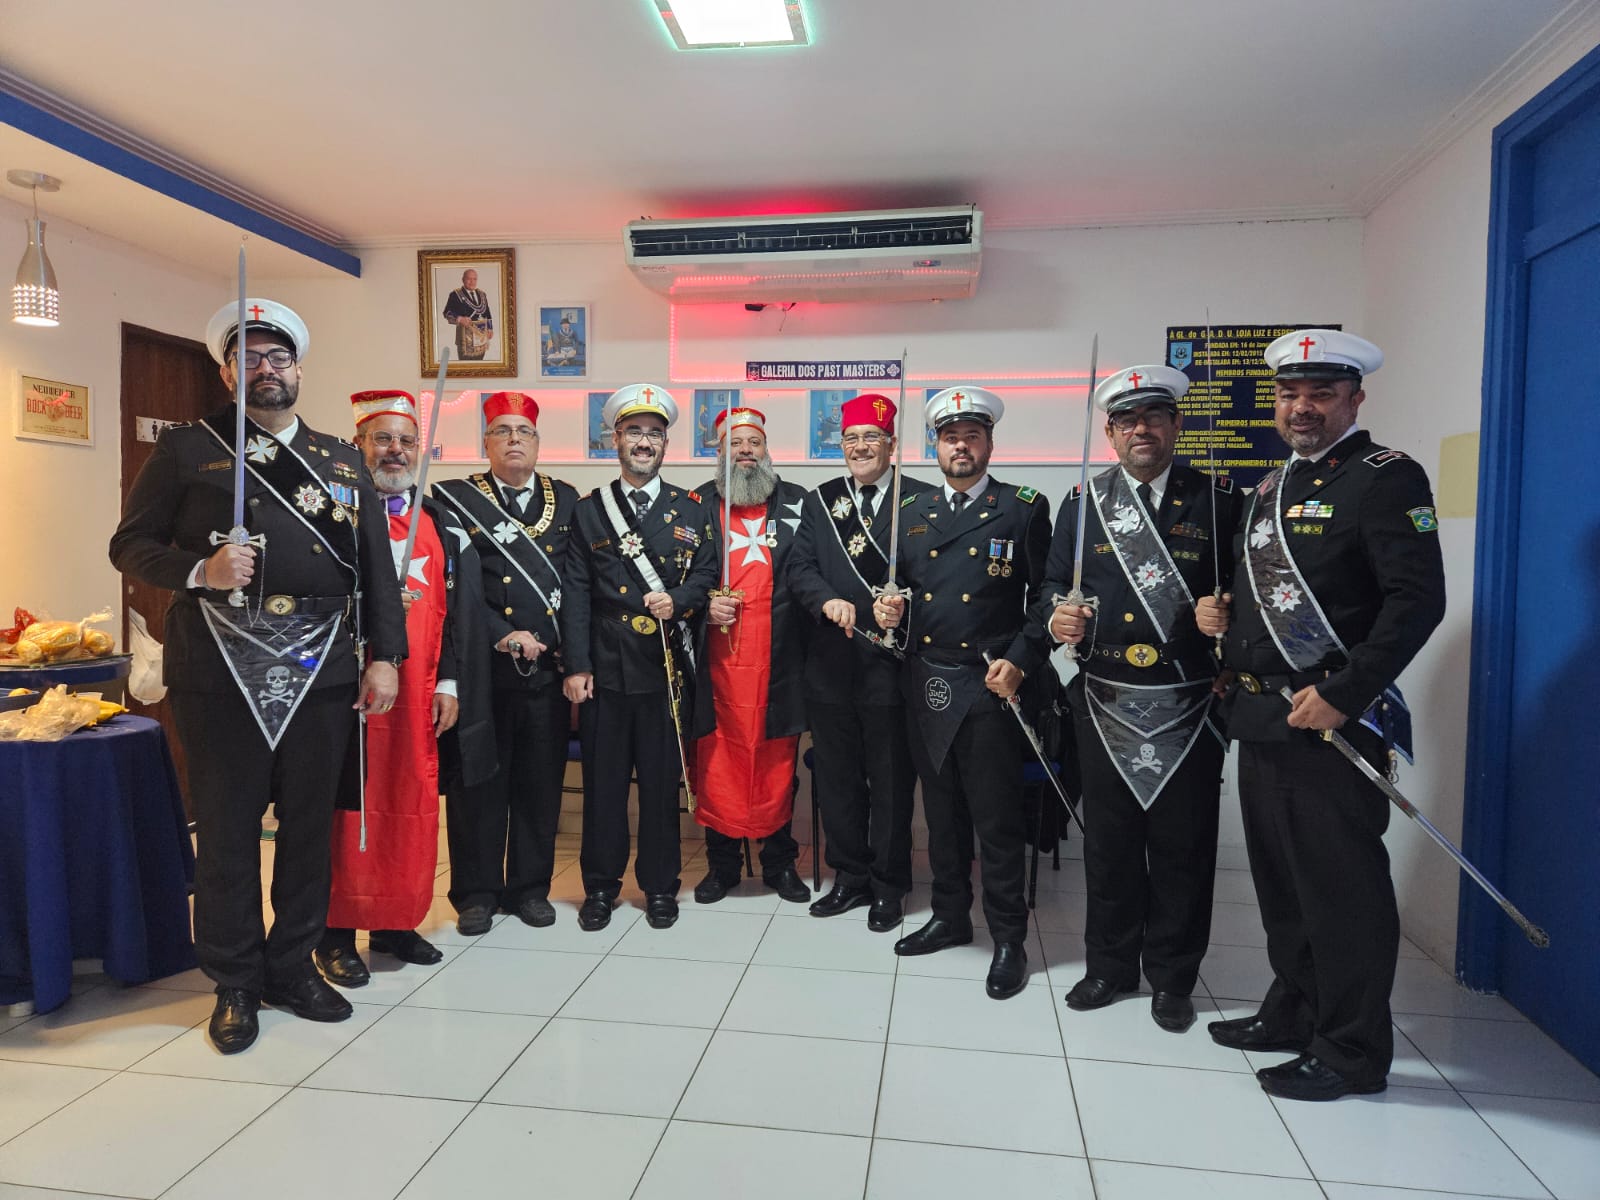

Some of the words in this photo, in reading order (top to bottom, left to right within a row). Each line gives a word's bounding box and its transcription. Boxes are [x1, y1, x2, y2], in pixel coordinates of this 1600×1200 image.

[1236, 329, 1252, 337] LOJA
[1253, 329, 1266, 337] LUZ
[1267, 329, 1272, 337] E
[761, 364, 796, 378] GALERIA
[798, 364, 816, 378] DOS
[818, 364, 841, 377] PAST
[843, 363, 886, 377] MASTERS
[1215, 369, 1245, 377] MEMBROS
[1216, 419, 1248, 427] PRIMEIROS
[1190, 459, 1222, 467] PRIMEIOS
[1223, 459, 1268, 467] COMPANHEIROS
